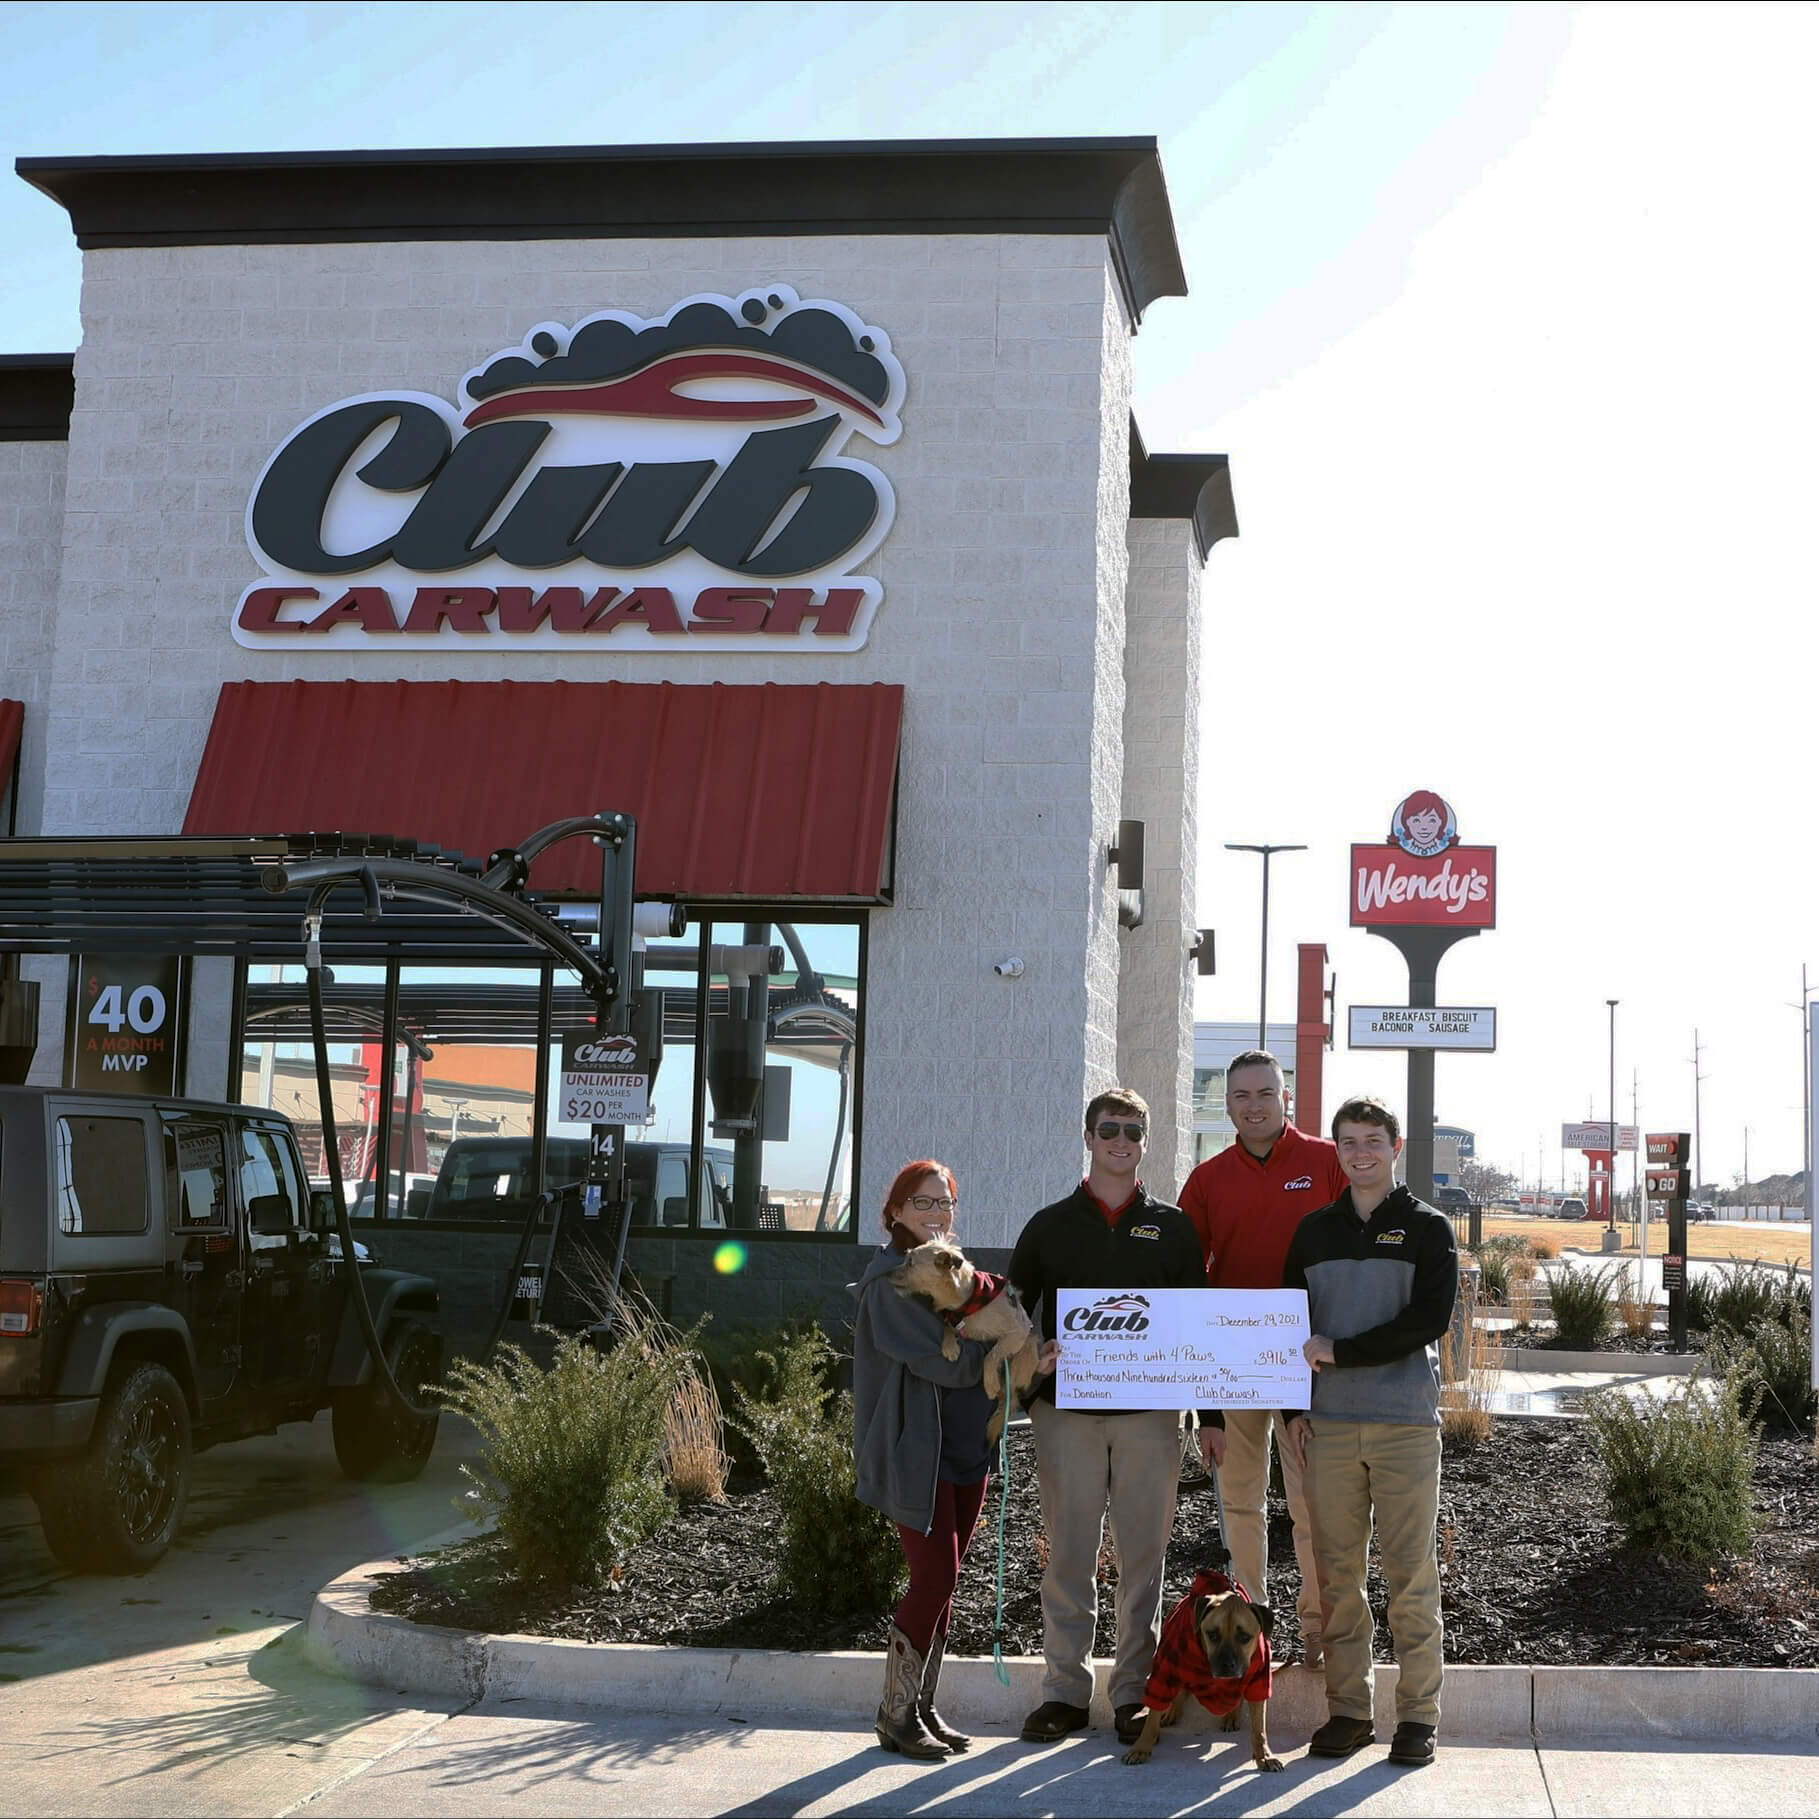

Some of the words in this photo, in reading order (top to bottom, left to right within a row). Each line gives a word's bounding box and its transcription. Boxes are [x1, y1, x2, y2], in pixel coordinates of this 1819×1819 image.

[252, 399, 878, 578] Club
[238, 586, 865, 636] CARWASH
[1357, 858, 1488, 914] Wendy's
[1382, 1011, 1436, 1022] BREAKFAST
[1442, 1012, 1478, 1023] BISCUIT
[1428, 1022, 1470, 1033] SAUSAGE
[87, 1038, 98, 1051] A
[102, 1038, 165, 1052] MONTH
[574, 1043, 636, 1064] Club
[102, 1054, 149, 1072] MVP
[566, 1073, 644, 1088] UNLIMITED
[576, 1088, 594, 1097] CAR
[596, 1088, 632, 1098] WASHES
[567, 1097, 606, 1120] $20
[608, 1101, 623, 1110] PER
[608, 1111, 641, 1121] MONTH
[592, 1133, 615, 1156] 14
[1648, 1143, 1668, 1154] WAIT
[1284, 1180, 1312, 1190] Club
[1659, 1177, 1677, 1192] GO
[518, 1276, 542, 1289] OWEL
[514, 1288, 542, 1299] ETUR
[1063, 1307, 1150, 1332] Club
[1216, 1314, 1262, 1327] December
[1278, 1313, 1301, 1325] 2021
[1062, 1333, 1149, 1341] CARWASH
[1094, 1348, 1139, 1363] Friends
[1143, 1347, 1166, 1362] with
[1170, 1346, 1179, 1362] 4
[1180, 1344, 1215, 1362] Paws
[1072, 1387, 1112, 1400] Donation
[1195, 1385, 1219, 1400] Club
[1220, 1385, 1260, 1400] Carwash
